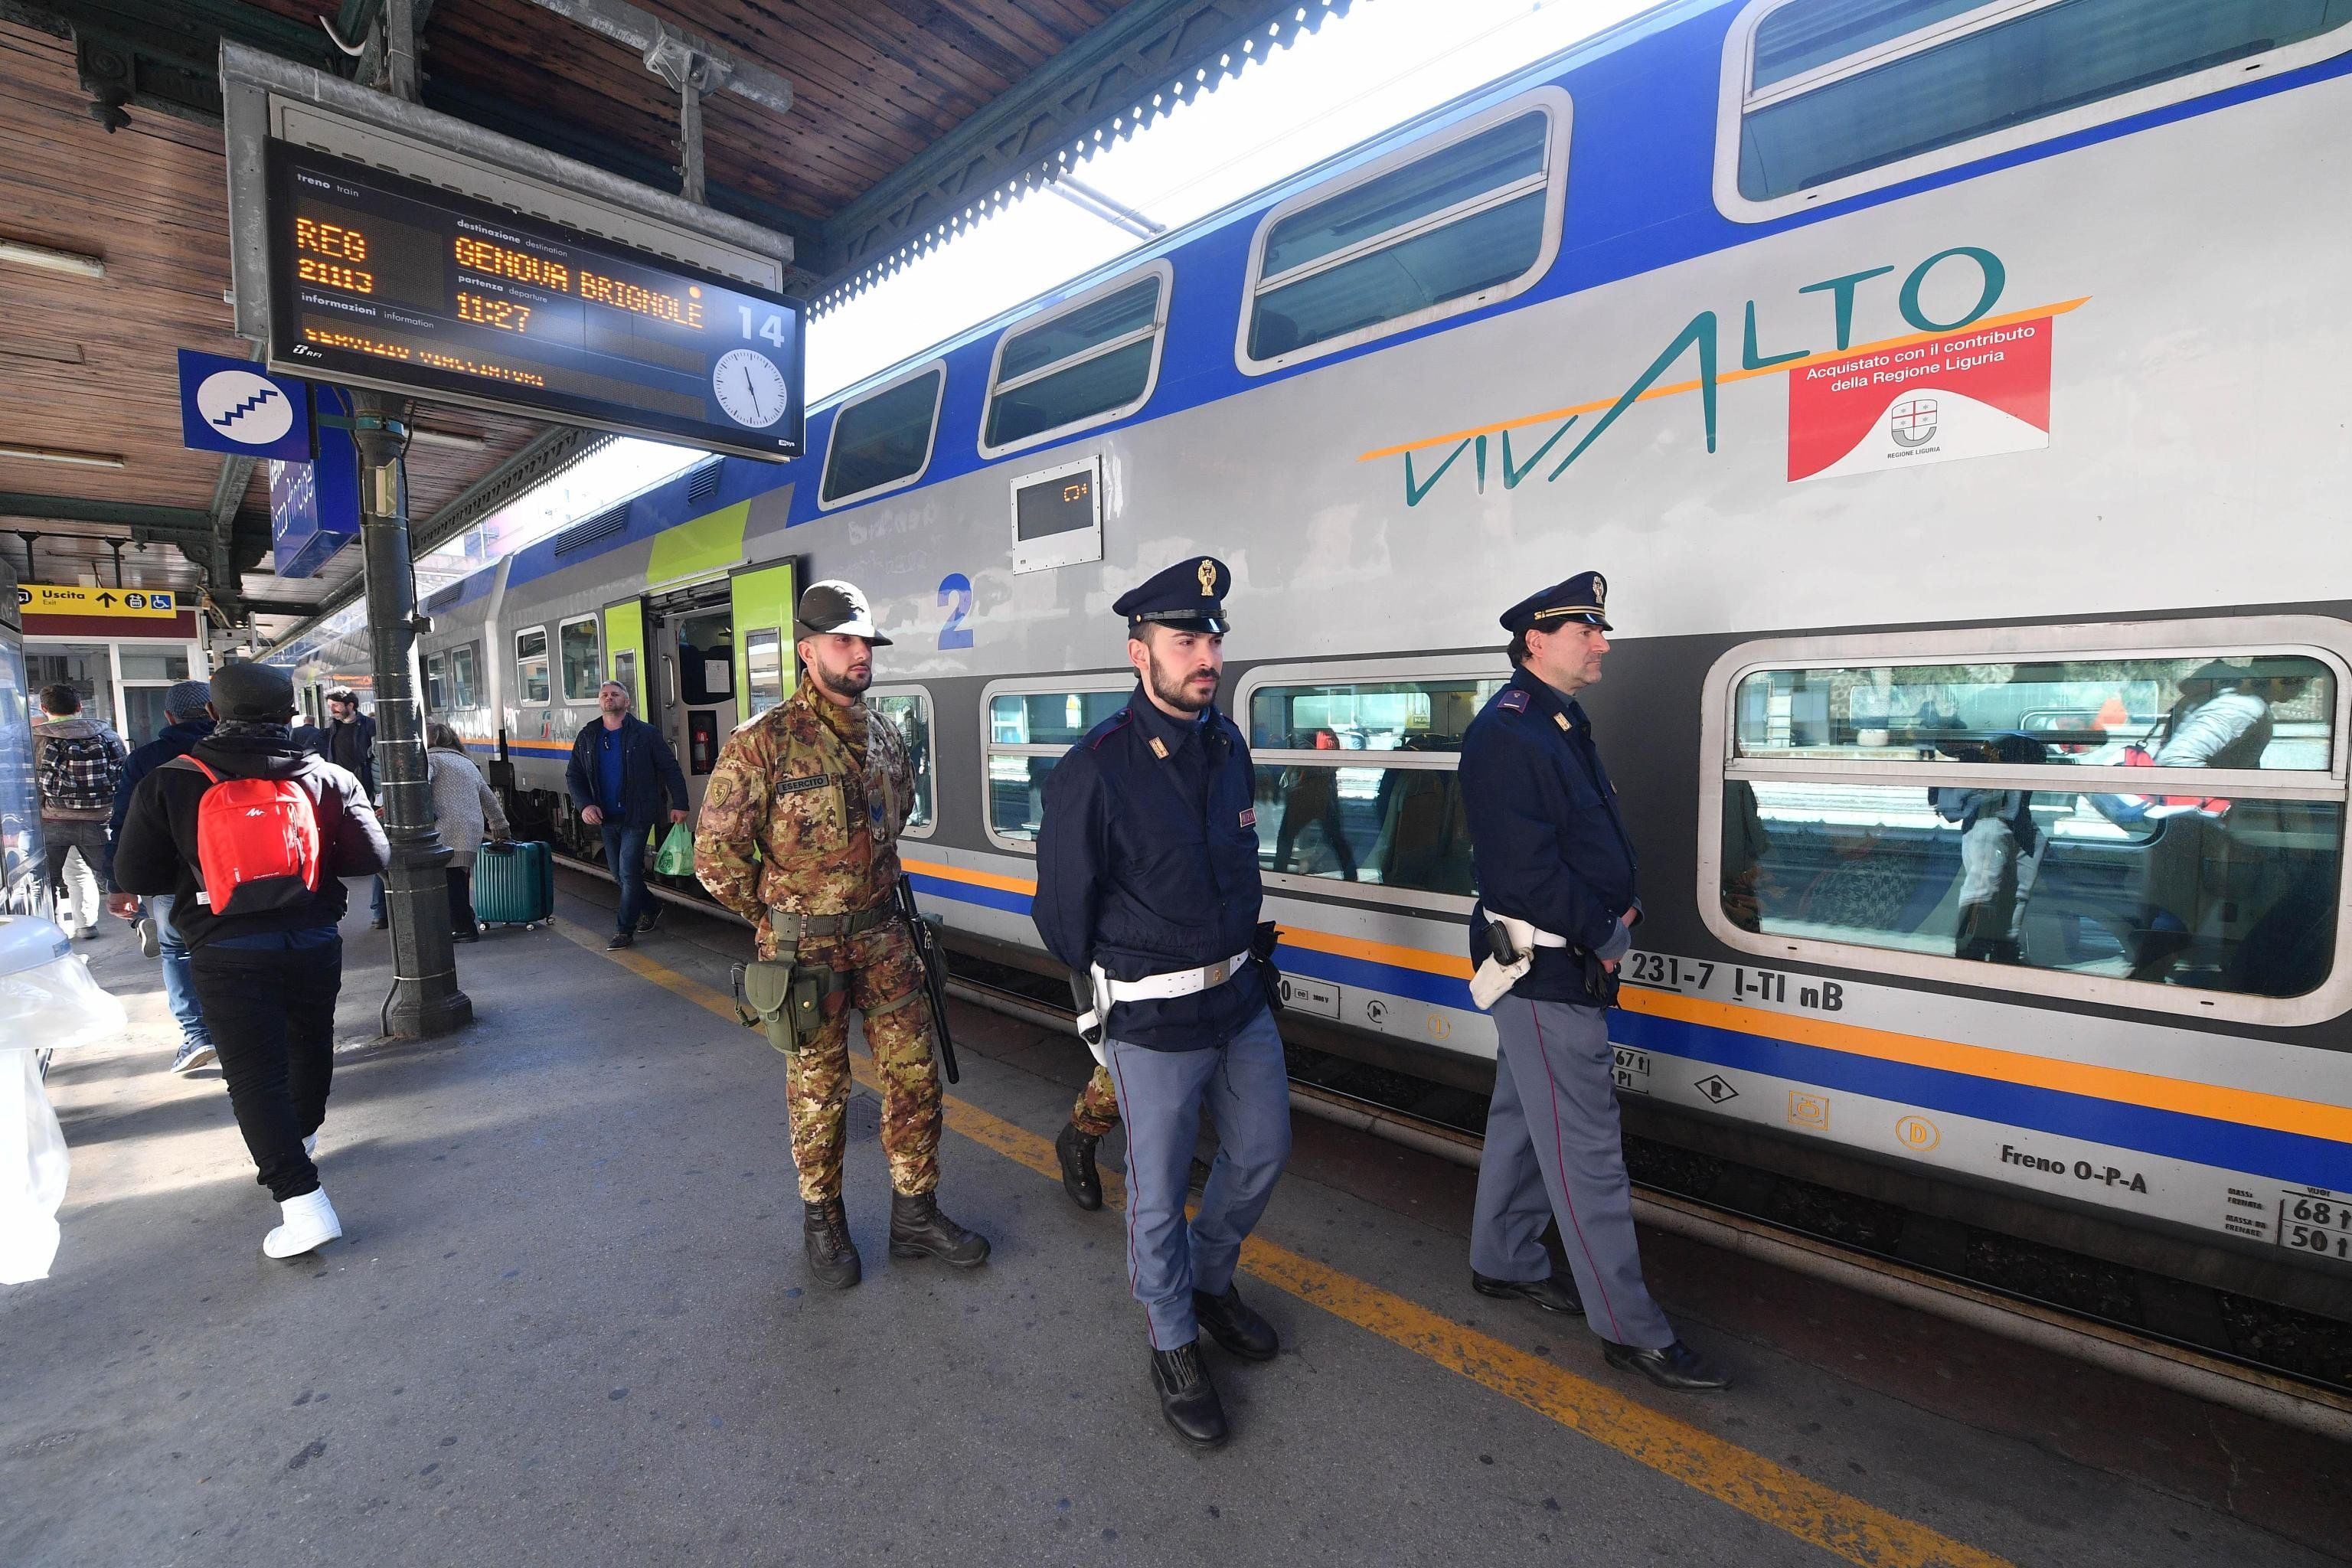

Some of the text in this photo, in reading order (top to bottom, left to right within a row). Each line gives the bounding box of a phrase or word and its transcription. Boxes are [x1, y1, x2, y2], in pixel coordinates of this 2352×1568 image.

[297, 173, 359, 198] treno train
[296, 217, 367, 262] REG
[457, 219, 568, 257] destinazione destination
[299, 259, 372, 294] 21113
[456, 237, 703, 328] GENOVA BRIGNOLE
[458, 275, 547, 303] partenza departure
[302, 292, 434, 329] informazioni information
[457, 292, 531, 332] 11:27
[738, 305, 785, 348] 14
[1806, 327, 2036, 381] Acquistato con il contributo
[1831, 350, 2005, 392] della Regione Liguria
[1887, 446, 1941, 459] REGIONE LIGURIA
[42, 590, 85, 599] Uscita
[936, 573, 975, 651] 2
[782, 778, 824, 791] ESERCITO
[1632, 952, 1714, 990] 231-7
[1800, 981, 1844, 1011] nB
[1638, 1057, 1645, 1070] t
[1910, 1122, 1927, 1143] D
[2001, 1144, 2147, 1194] Freno O-P-A
[2225, 1214, 2252, 1226] MASSA
[2227, 1197, 2263, 1210] FRENATA
[2293, 1199, 2352, 1230] 68 t
[2225, 1223, 2261, 1237] FRENARE
[2291, 1226, 2347, 1257] 50 t
